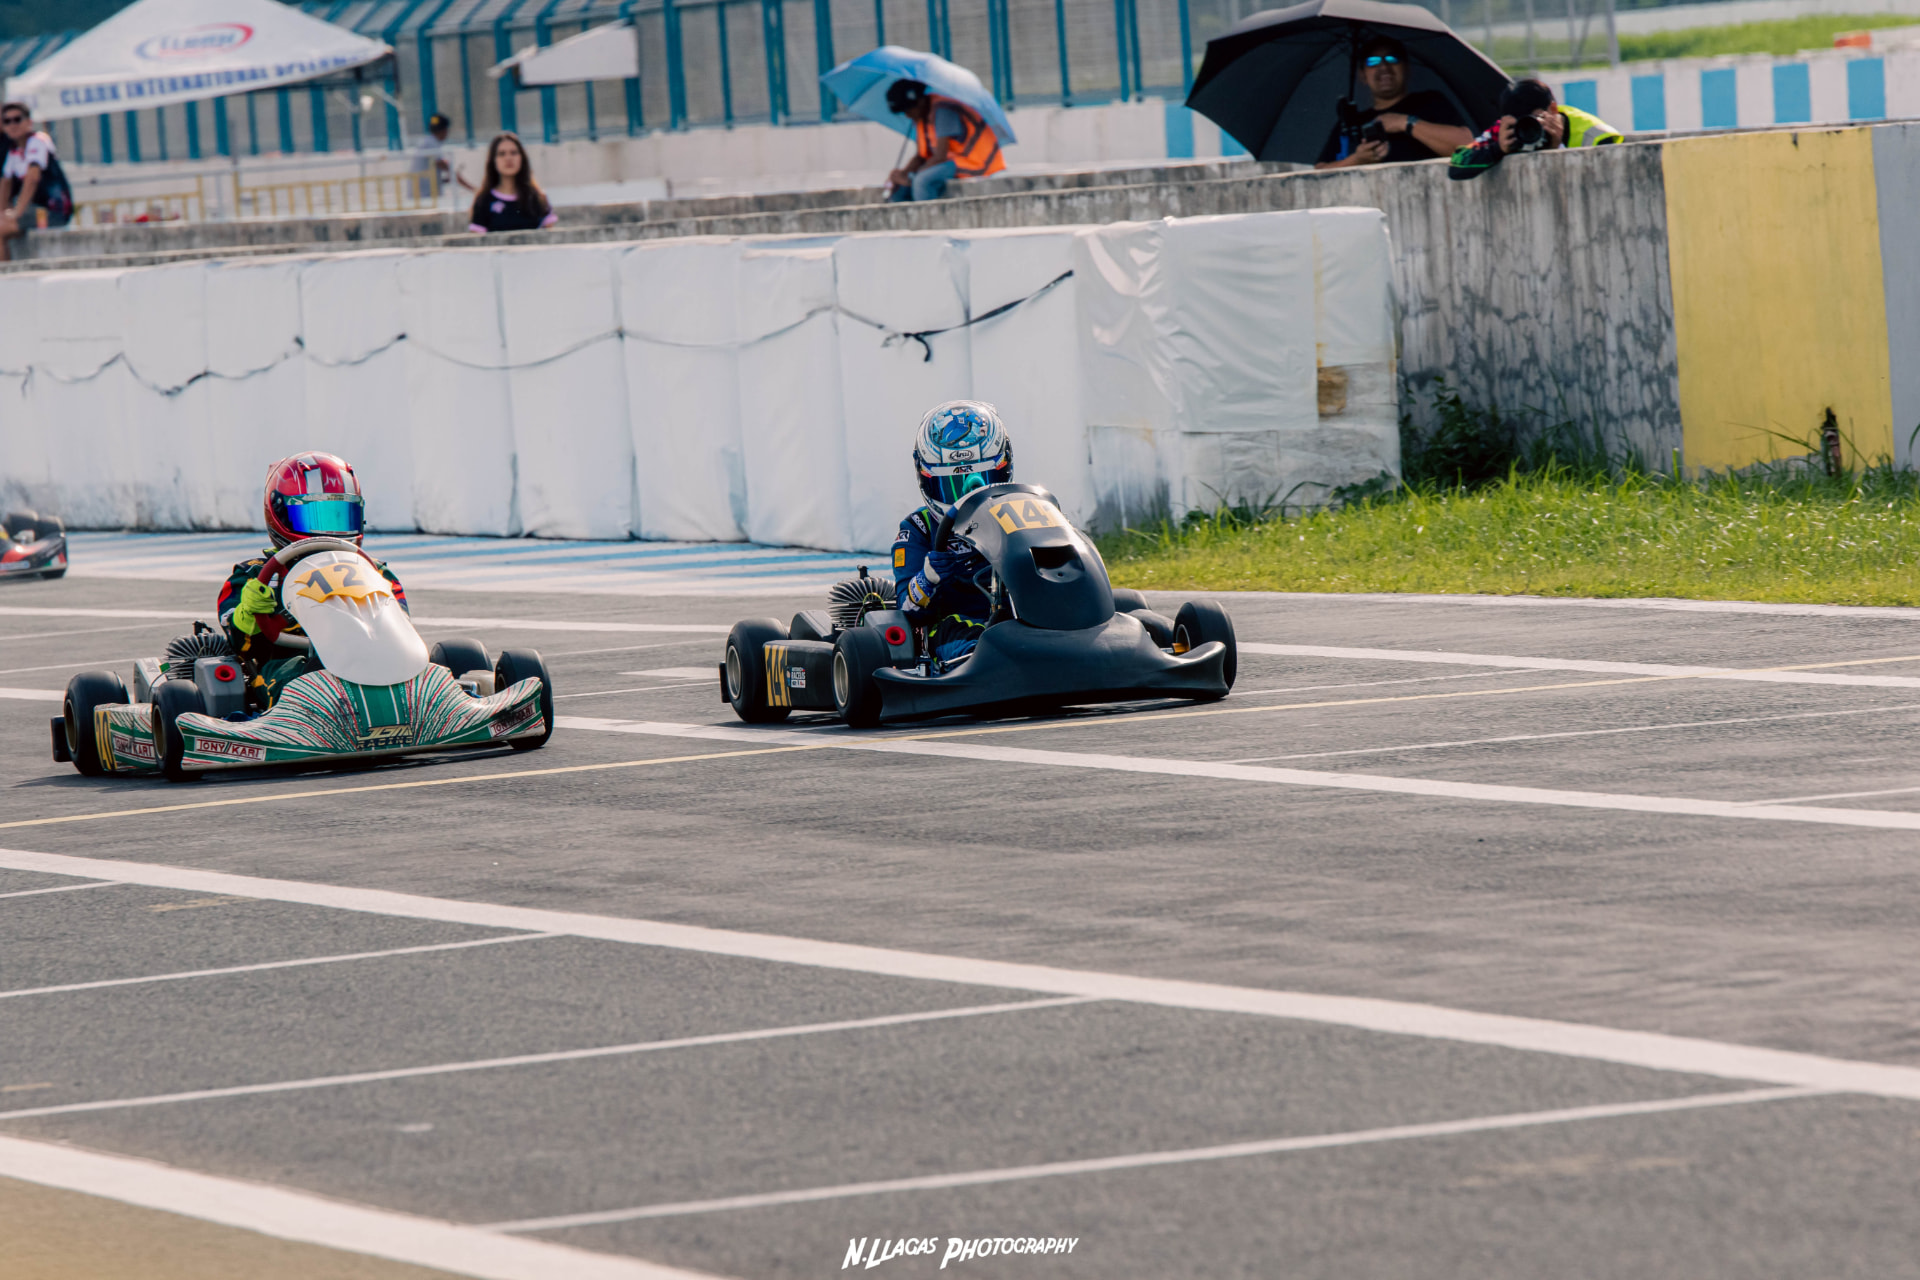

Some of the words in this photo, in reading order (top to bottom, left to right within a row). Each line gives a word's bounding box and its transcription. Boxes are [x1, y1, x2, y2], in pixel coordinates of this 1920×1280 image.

[132, 742, 154, 757] KART
[197, 739, 227, 753] TONY
[231, 744, 263, 759] KART
[357, 736, 414, 748] RACING
